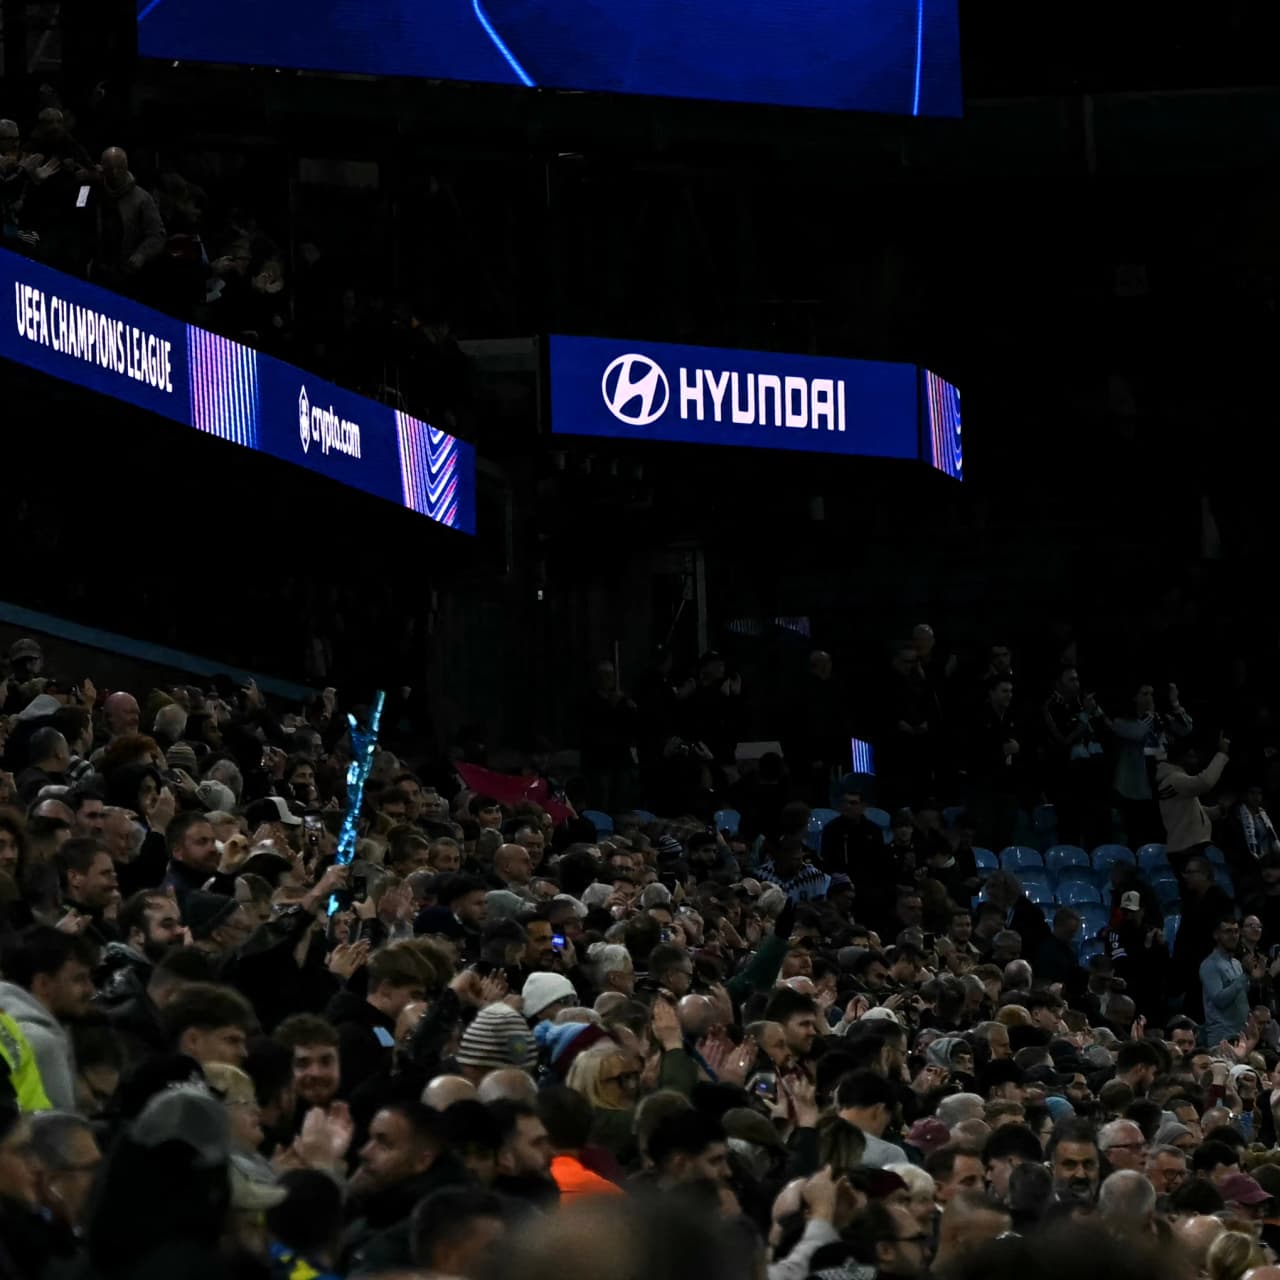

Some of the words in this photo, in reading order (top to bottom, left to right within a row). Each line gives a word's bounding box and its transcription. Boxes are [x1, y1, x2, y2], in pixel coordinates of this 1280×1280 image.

[15, 281, 50, 347] UEFA
[50, 295, 125, 374] CHAMPIONS
[126, 324, 173, 393] LEAGUE
[311, 405, 361, 459] crypto.com
[679, 367, 846, 432] HYUNDAI
